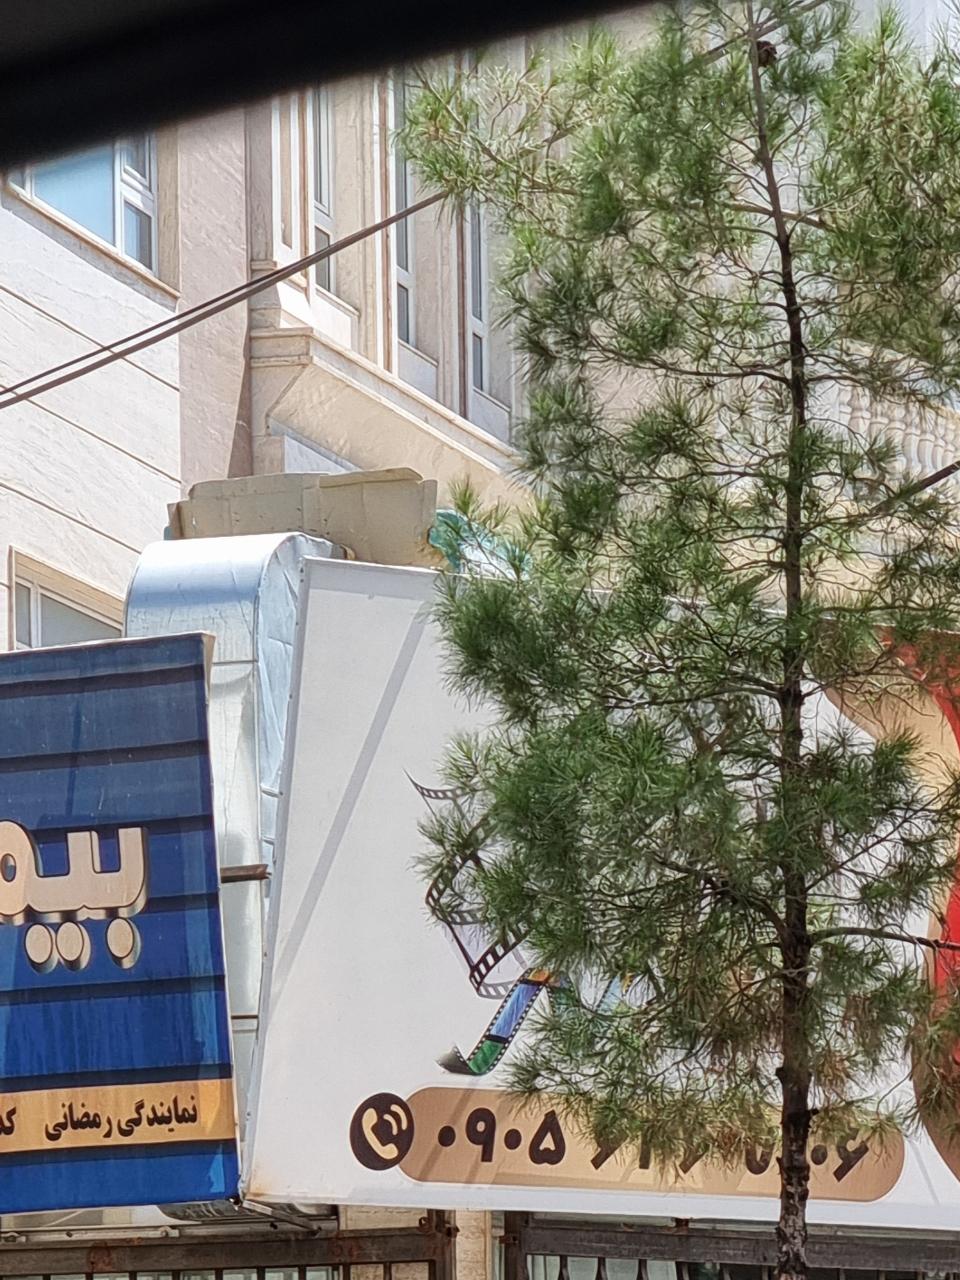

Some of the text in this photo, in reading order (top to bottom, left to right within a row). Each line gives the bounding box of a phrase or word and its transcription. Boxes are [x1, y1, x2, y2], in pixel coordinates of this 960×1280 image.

[0, 819, 146, 970] بیم
[44, 1102, 113, 1142] رمضانی
[118, 1094, 198, 1137] نمایندگی
